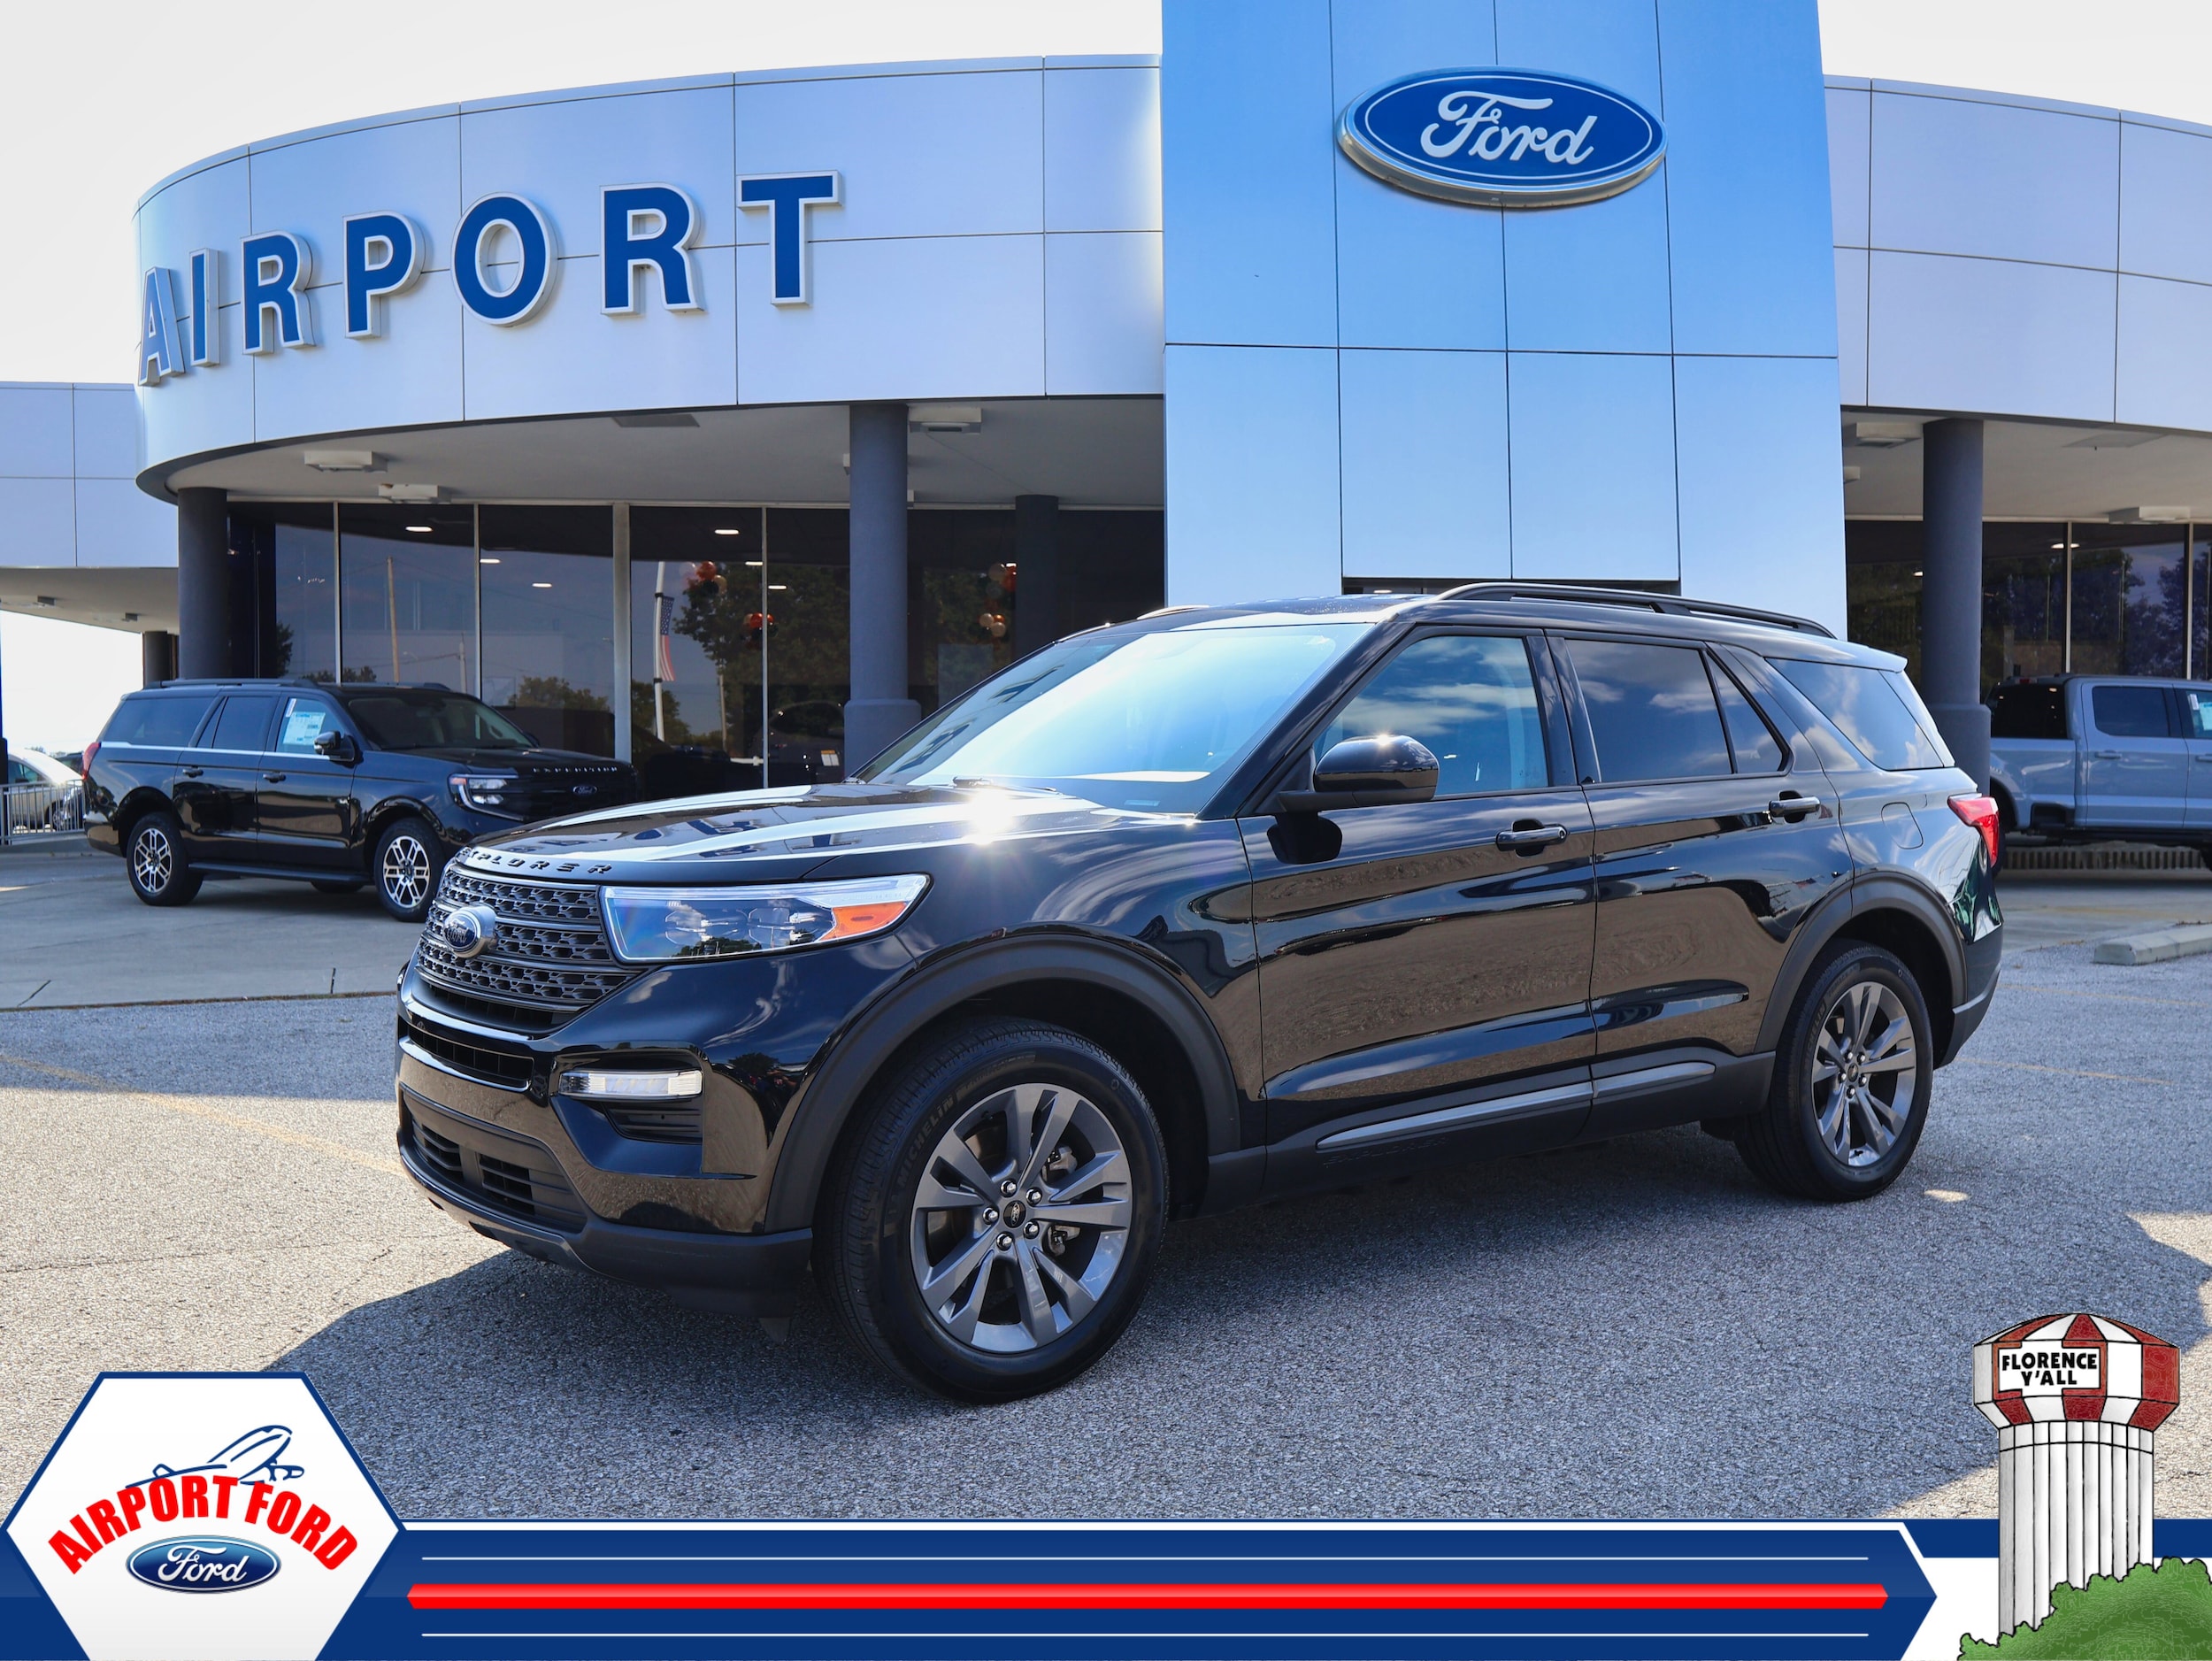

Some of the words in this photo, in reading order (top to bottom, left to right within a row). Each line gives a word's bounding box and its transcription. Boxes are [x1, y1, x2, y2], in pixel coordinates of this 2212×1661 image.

[1420, 90, 1598, 165] Ford
[138, 170, 843, 387] AIRPORT
[460, 846, 613, 874] EXPLORER
[896, 1094, 956, 1188] MICHELIN
